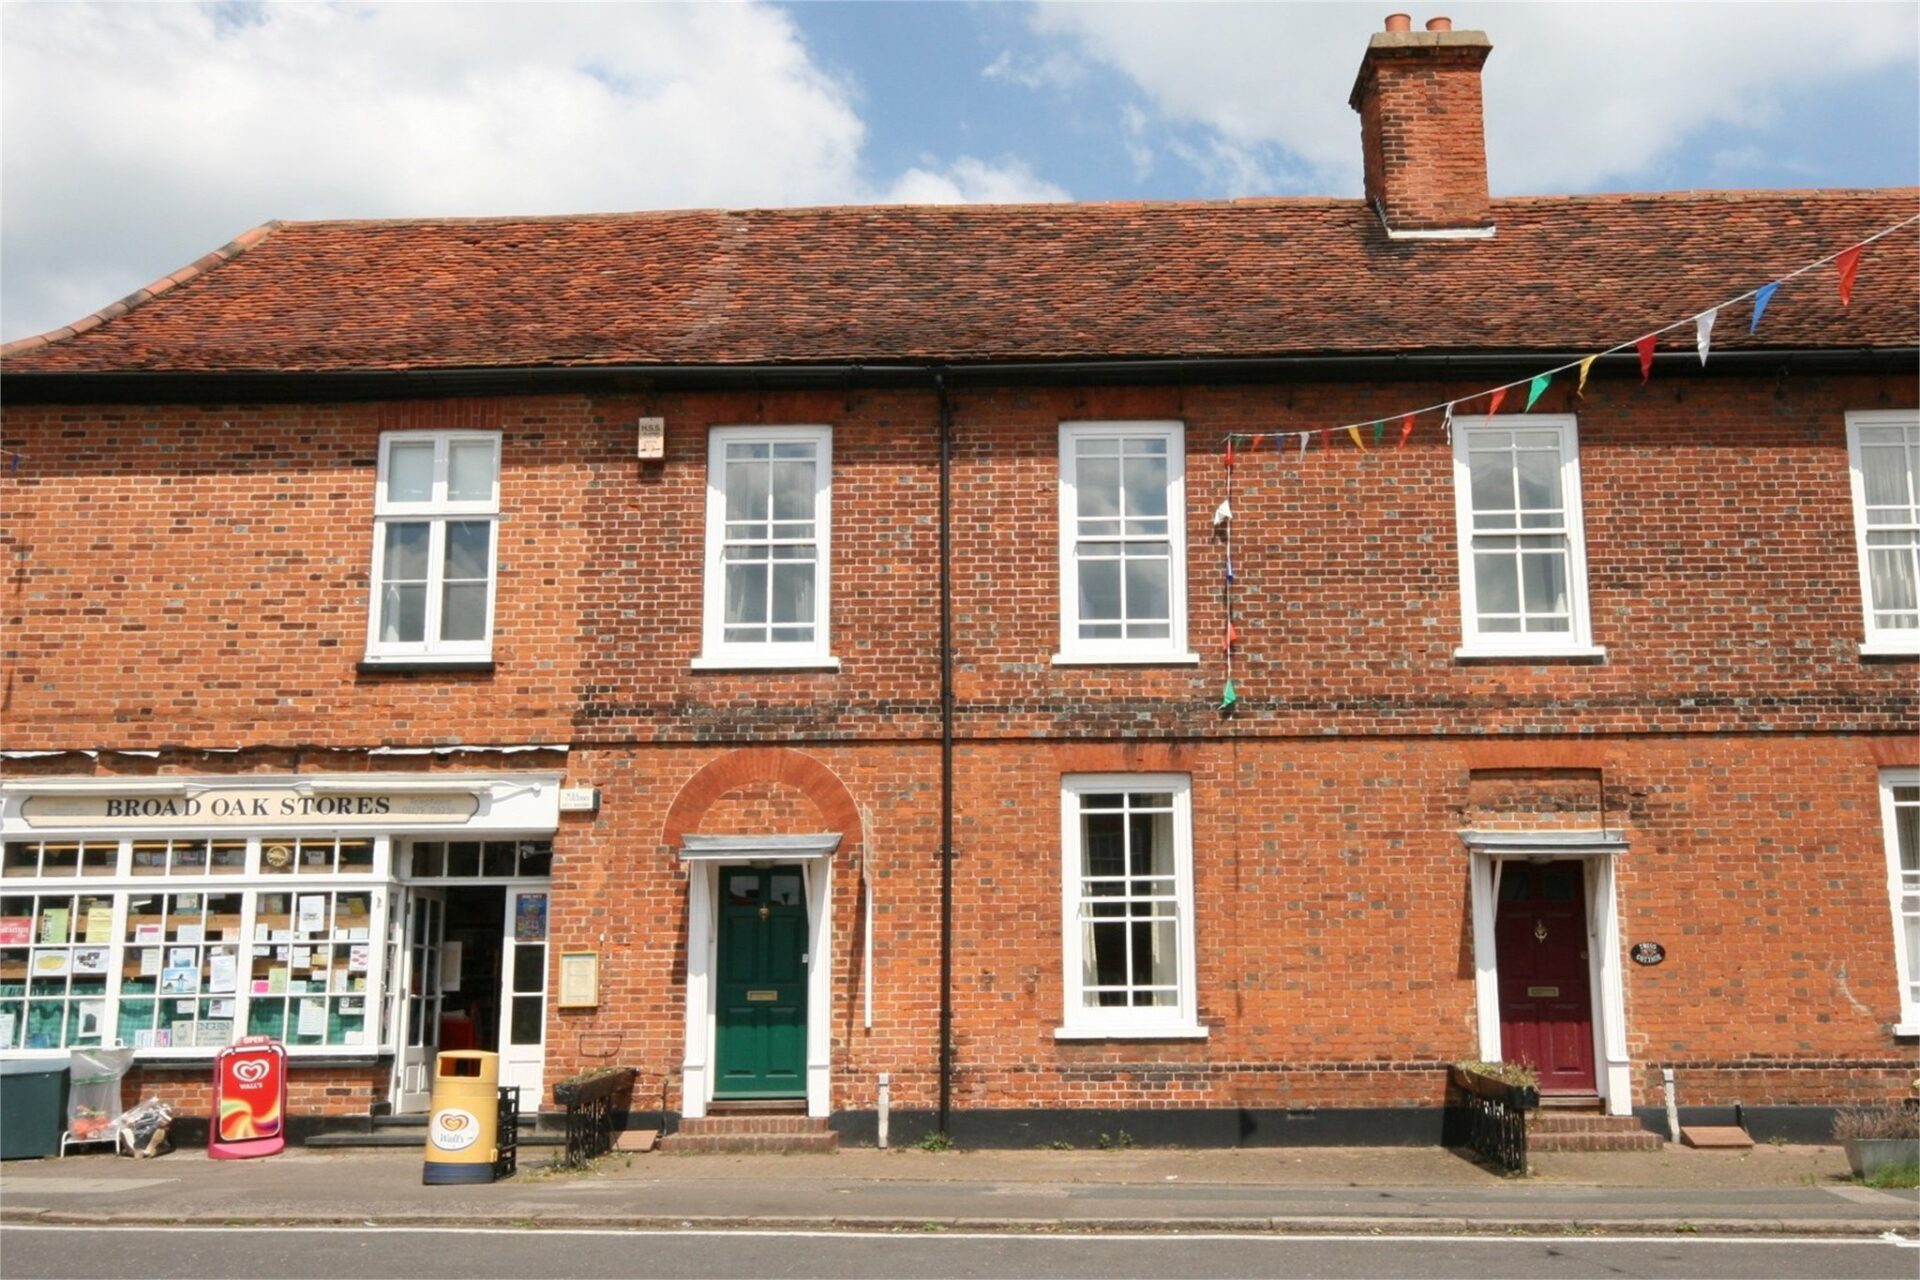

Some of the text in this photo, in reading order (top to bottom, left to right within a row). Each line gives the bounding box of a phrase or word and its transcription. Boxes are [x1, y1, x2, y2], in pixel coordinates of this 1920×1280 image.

[106, 798, 200, 817] BROAD
[211, 798, 270, 817] OAK
[280, 797, 390, 816] STORES
[243, 1036, 264, 1044] OPEN
